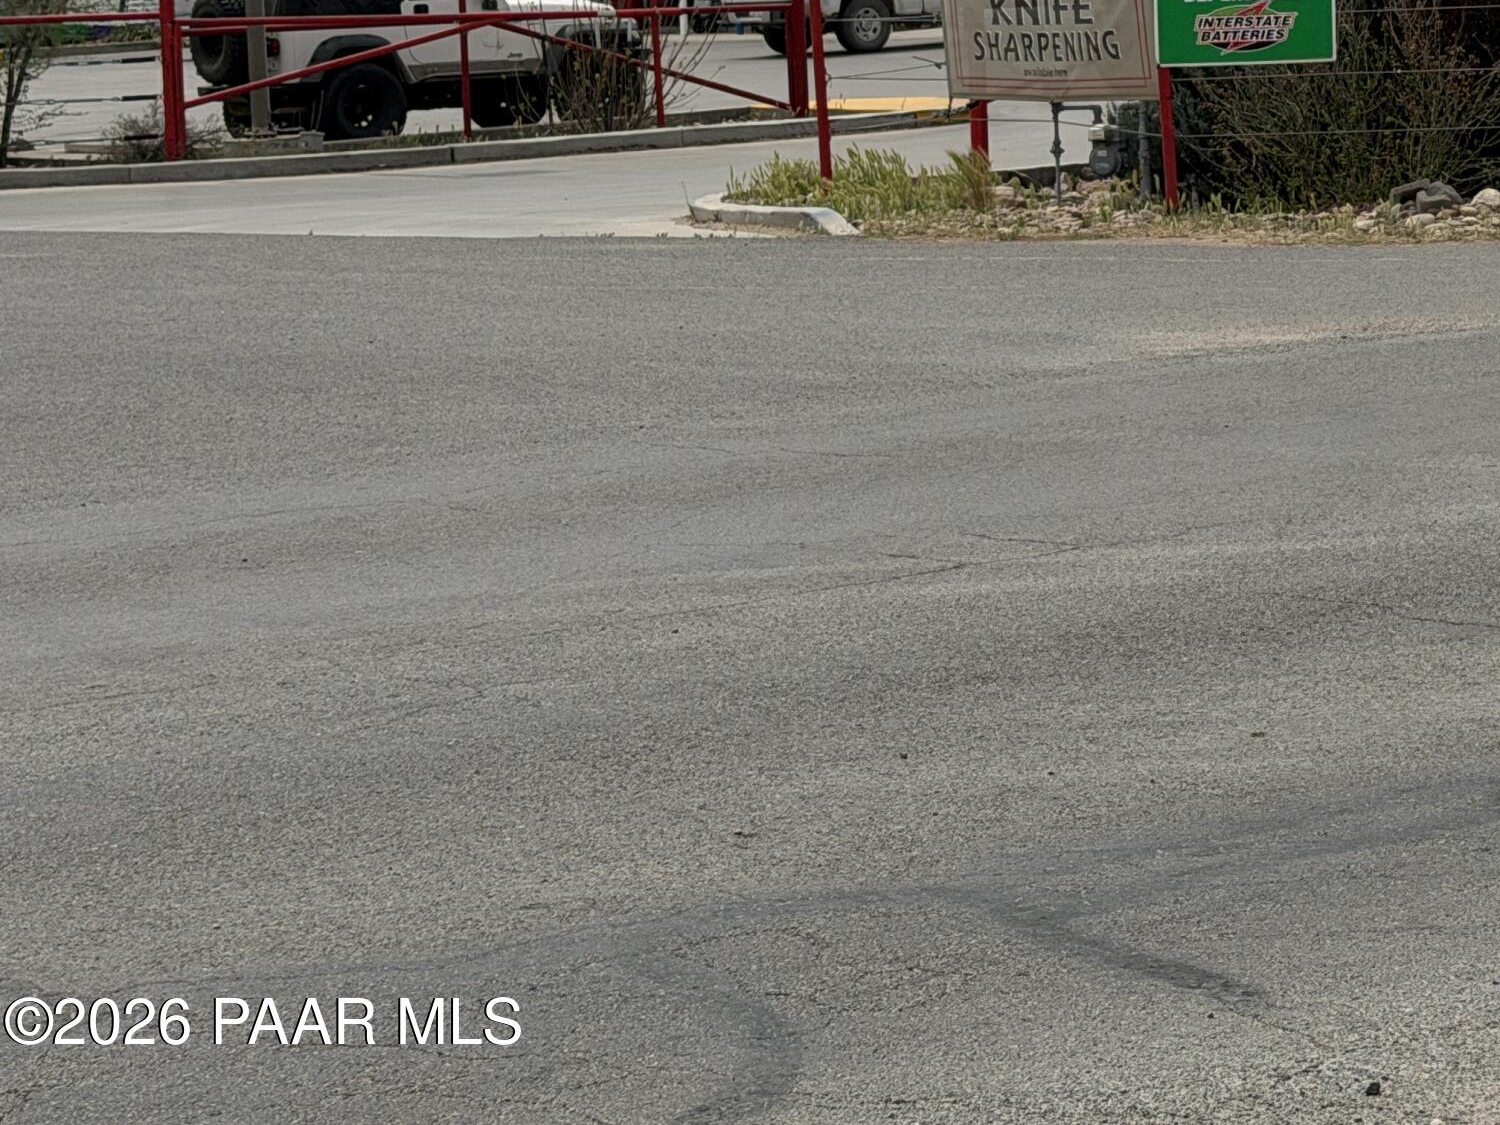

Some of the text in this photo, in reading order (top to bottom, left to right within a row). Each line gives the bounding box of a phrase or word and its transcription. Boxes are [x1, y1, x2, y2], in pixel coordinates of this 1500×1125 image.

[1198, 15, 1292, 28] INTERSTATE
[1201, 28, 1285, 42] BATTERIES
[974, 30, 1121, 62] SHARPENING
